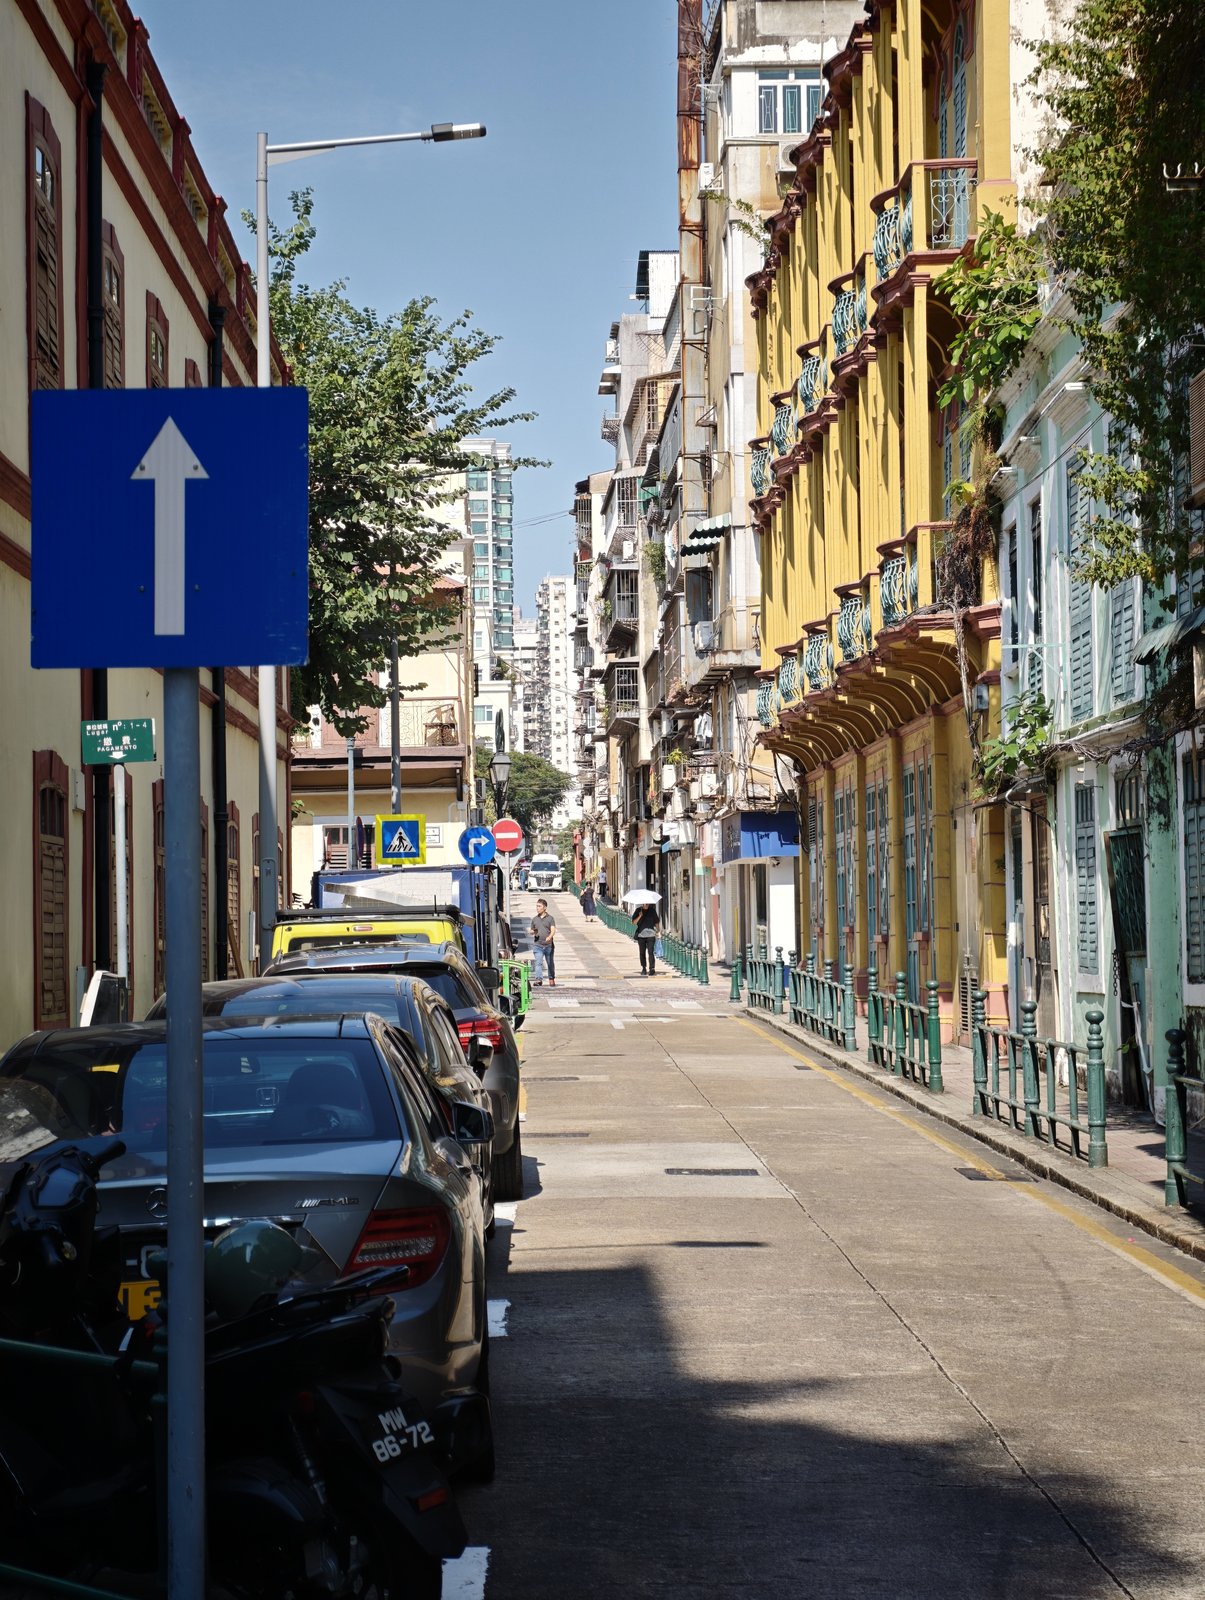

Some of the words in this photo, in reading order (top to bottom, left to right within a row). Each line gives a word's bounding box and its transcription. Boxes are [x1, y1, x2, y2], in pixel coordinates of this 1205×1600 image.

[96, 744, 137, 752] PAGAMENTO
[378, 1406, 408, 1434] MW
[372, 1421, 435, 1463] 86-72
